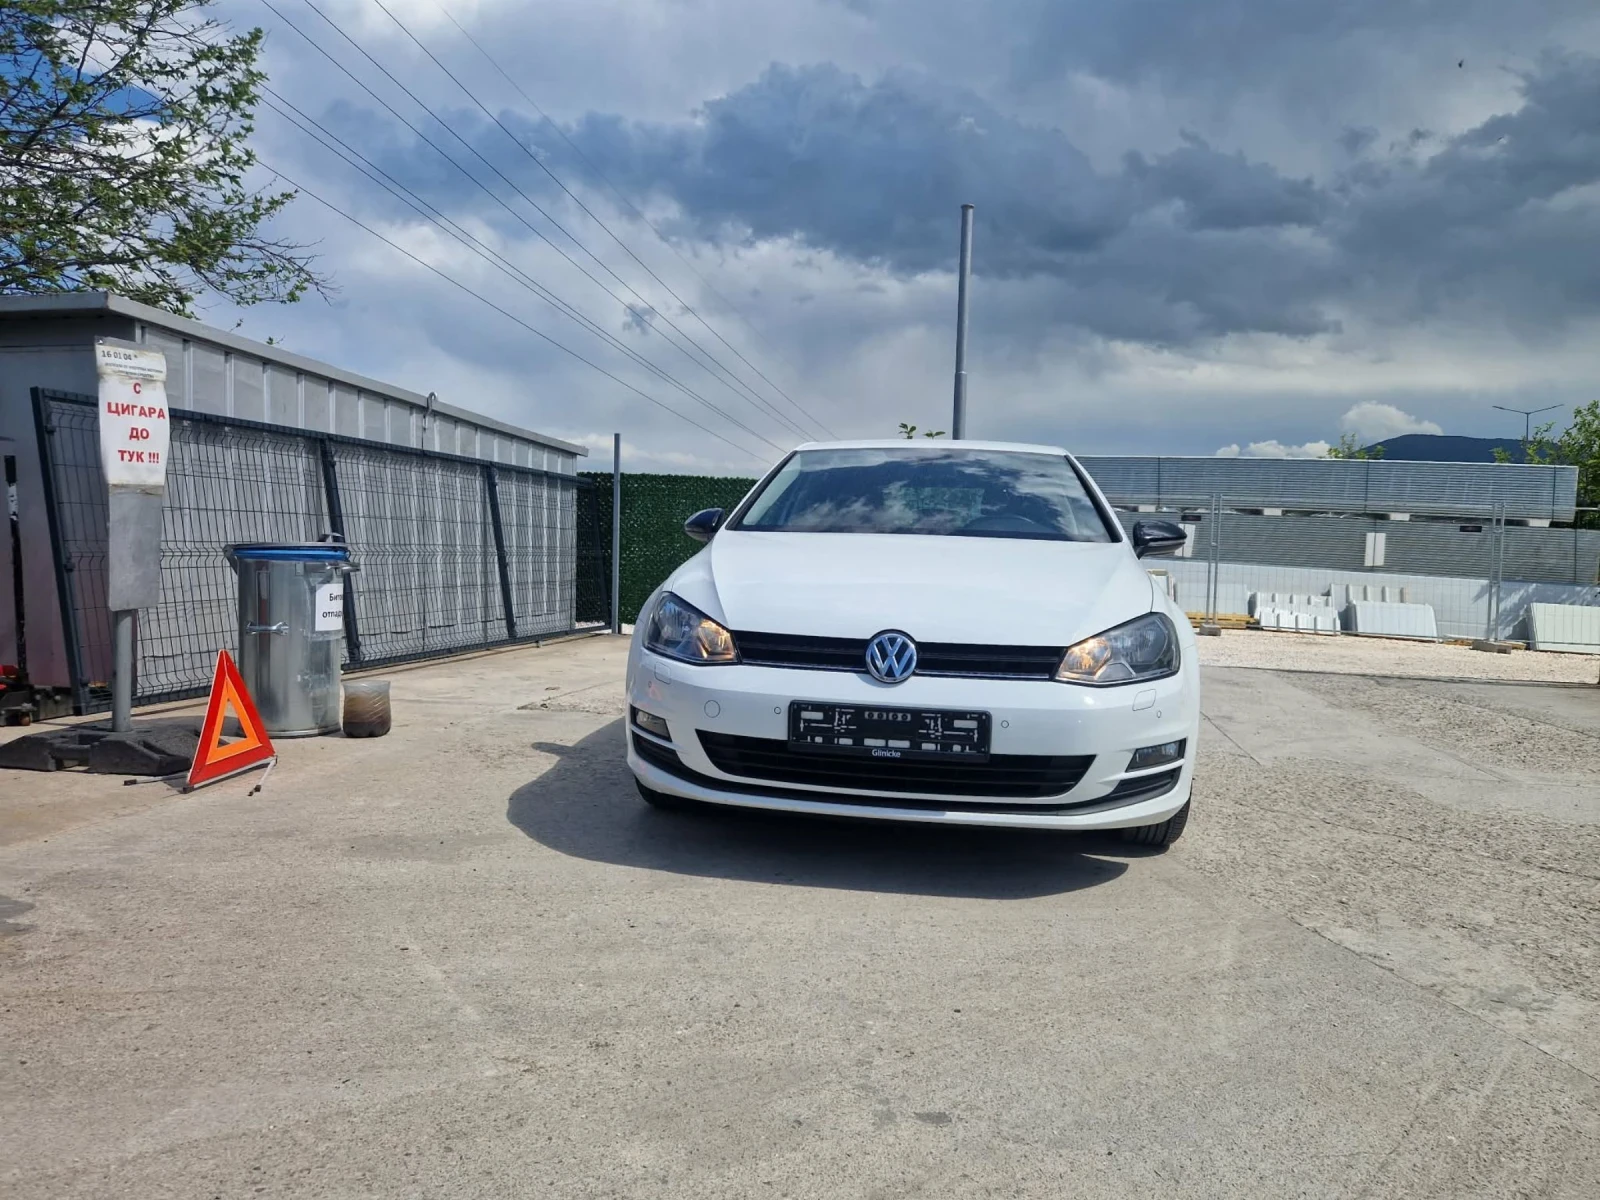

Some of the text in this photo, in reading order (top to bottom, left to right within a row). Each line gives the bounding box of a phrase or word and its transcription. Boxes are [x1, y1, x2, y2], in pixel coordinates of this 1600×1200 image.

[101, 350, 112, 358] 16
[113, 351, 122, 359] 01
[133, 382, 142, 395] С
[107, 402, 166, 419] ЦИГАРА
[129, 427, 150, 441] ДО
[118, 450, 145, 463] ТУК
[871, 748, 901, 761] Glinicke
